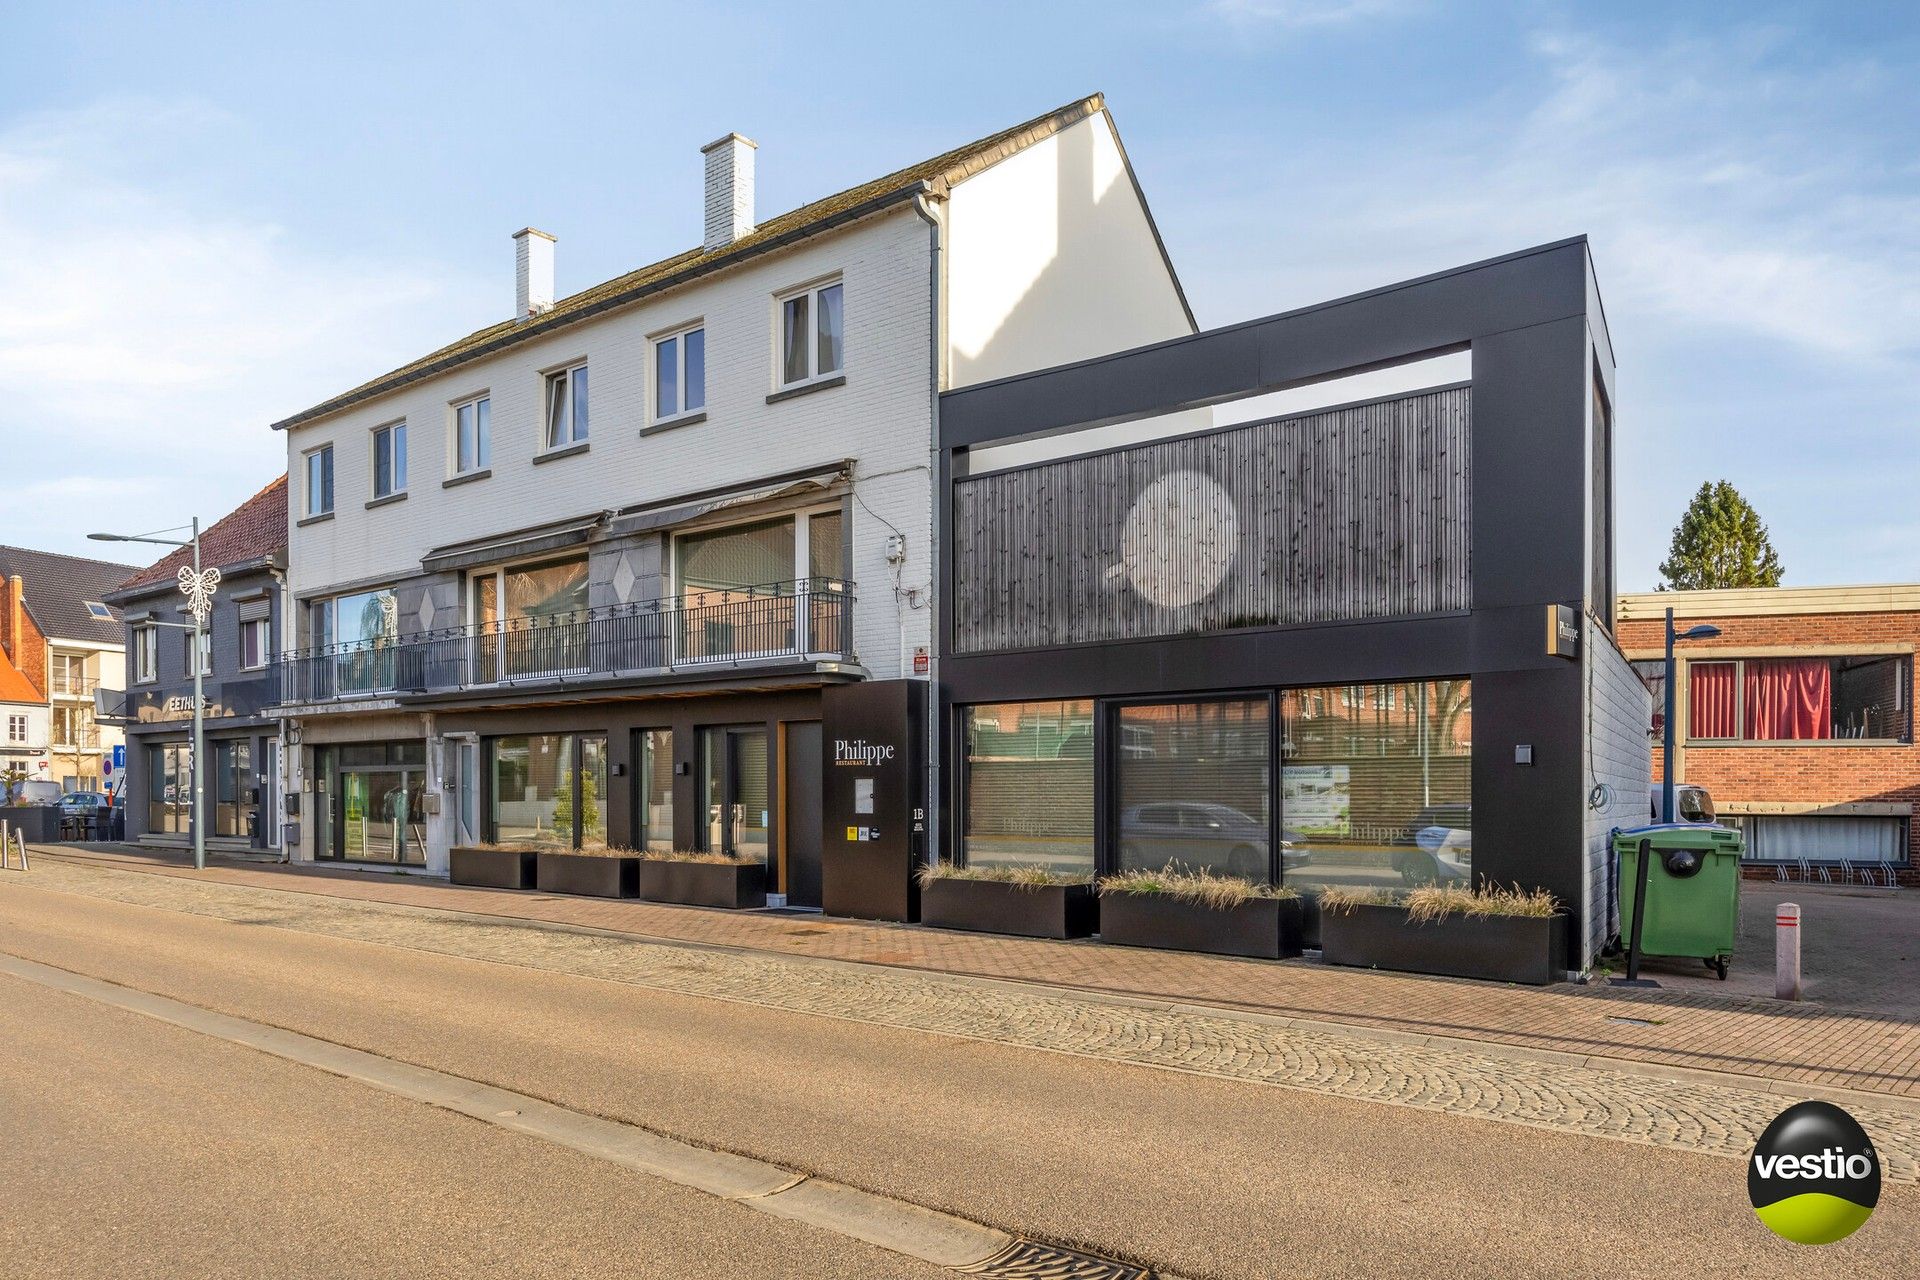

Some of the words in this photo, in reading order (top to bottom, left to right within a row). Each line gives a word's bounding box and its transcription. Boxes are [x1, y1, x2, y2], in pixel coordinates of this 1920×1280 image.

[169, 694, 206, 712] EETHUS
[834, 739, 895, 766] Philippe
[913, 808, 924, 820] 1B
